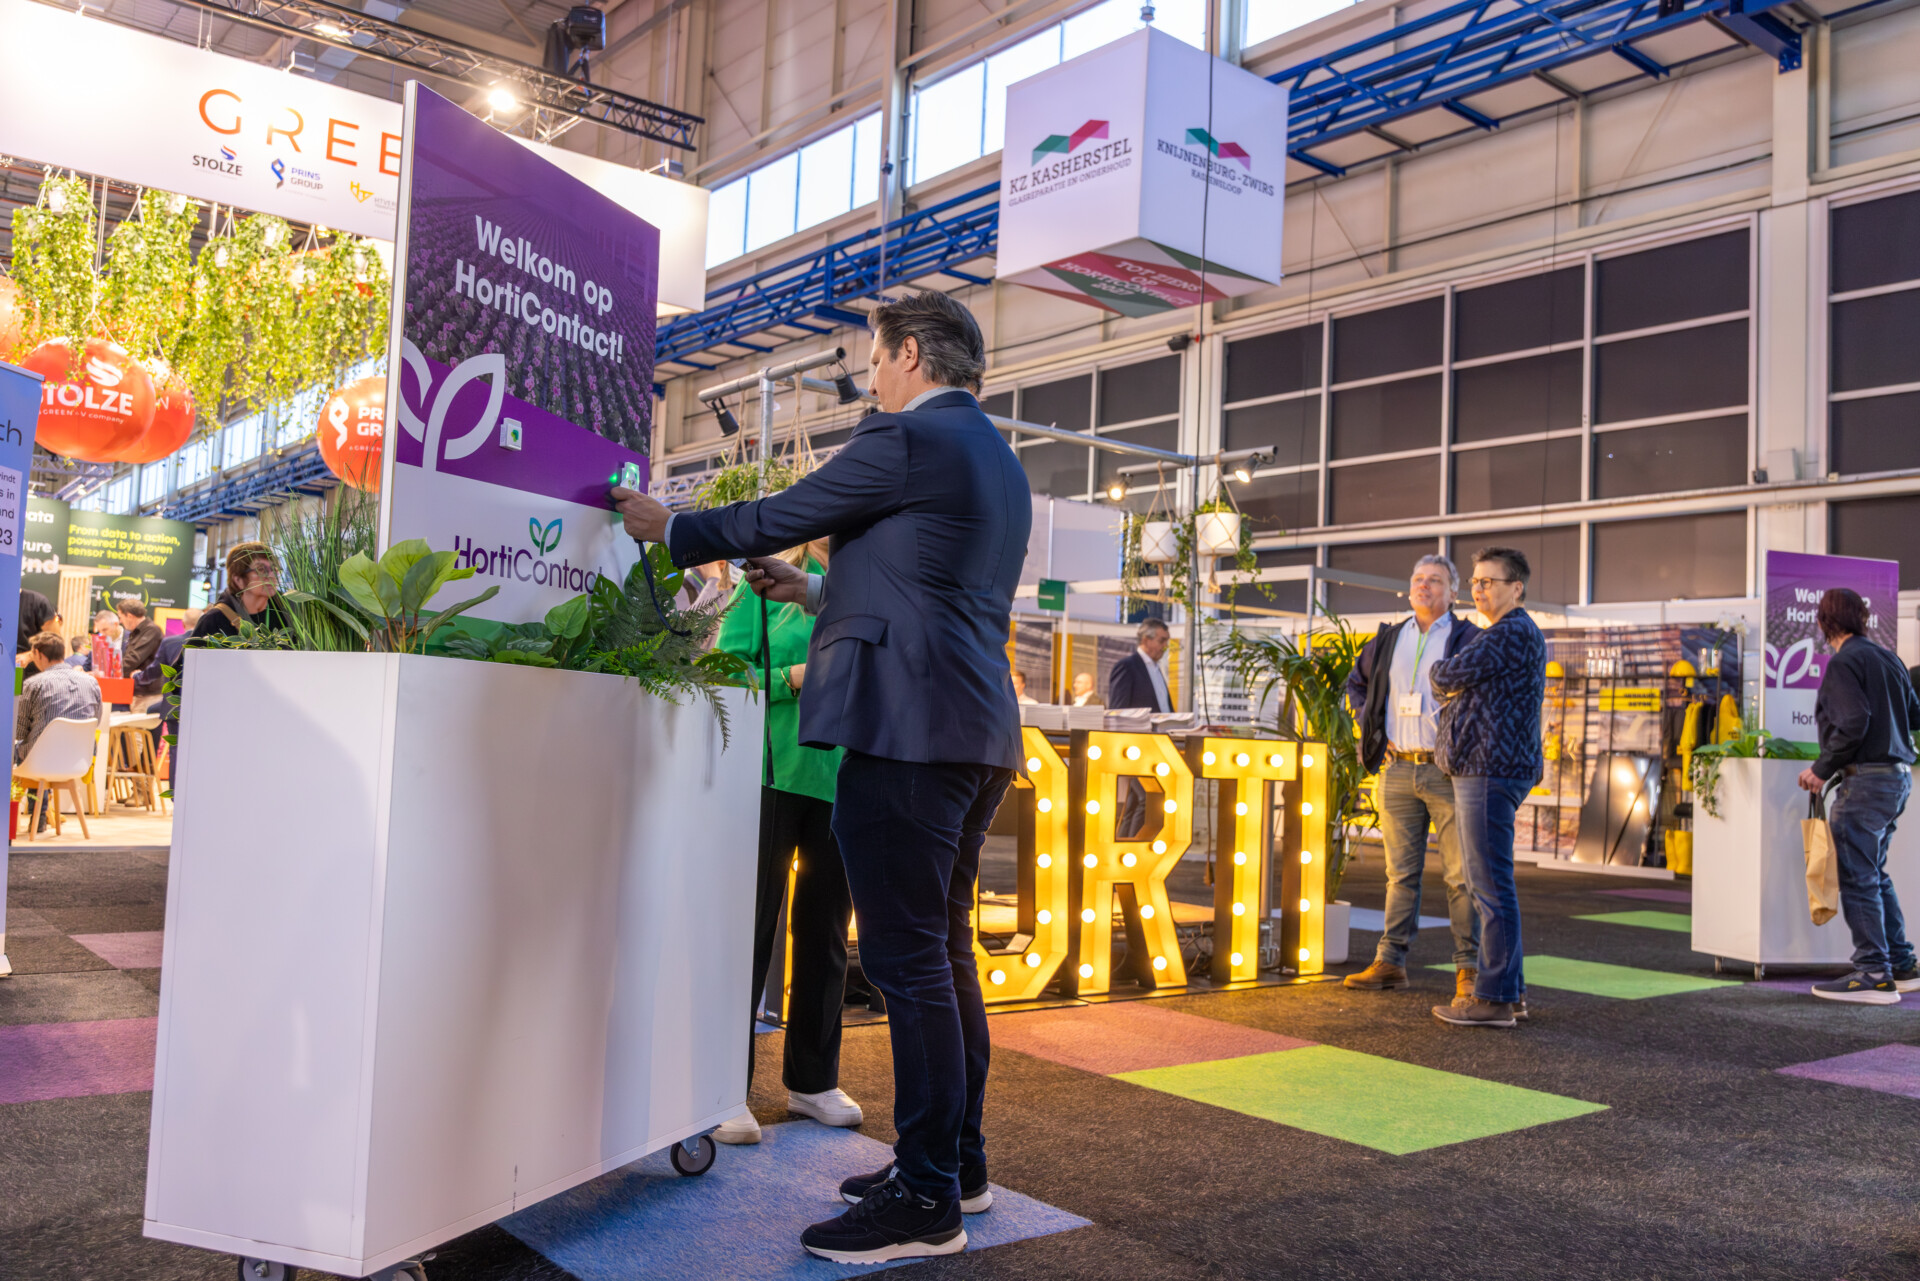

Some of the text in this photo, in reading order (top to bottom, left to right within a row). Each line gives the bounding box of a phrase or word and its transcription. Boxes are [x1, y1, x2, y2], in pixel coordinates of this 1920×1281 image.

[192, 154, 243, 177] STOLZE
[291, 167, 321, 181] PRINS
[1009, 138, 1132, 195] KZ KASHERSTEL
[290, 177, 324, 190] GROUP
[475, 214, 613, 316] Welkom op
[1059, 262, 1193, 306] HORTICONTACT
[1115, 261, 1201, 292] TOT ZIENS
[1130, 275, 1158, 287] OP
[455, 258, 623, 364] HortiContact!
[40, 383, 133, 416] TOLZE
[88, 413, 124, 424] company
[6, 488, 15, 501] in
[69, 524, 98, 536] From
[100, 528, 127, 539] data
[129, 531, 141, 541] to
[68, 536, 173, 555] powered by proven
[68, 547, 167, 566] sensor technology
